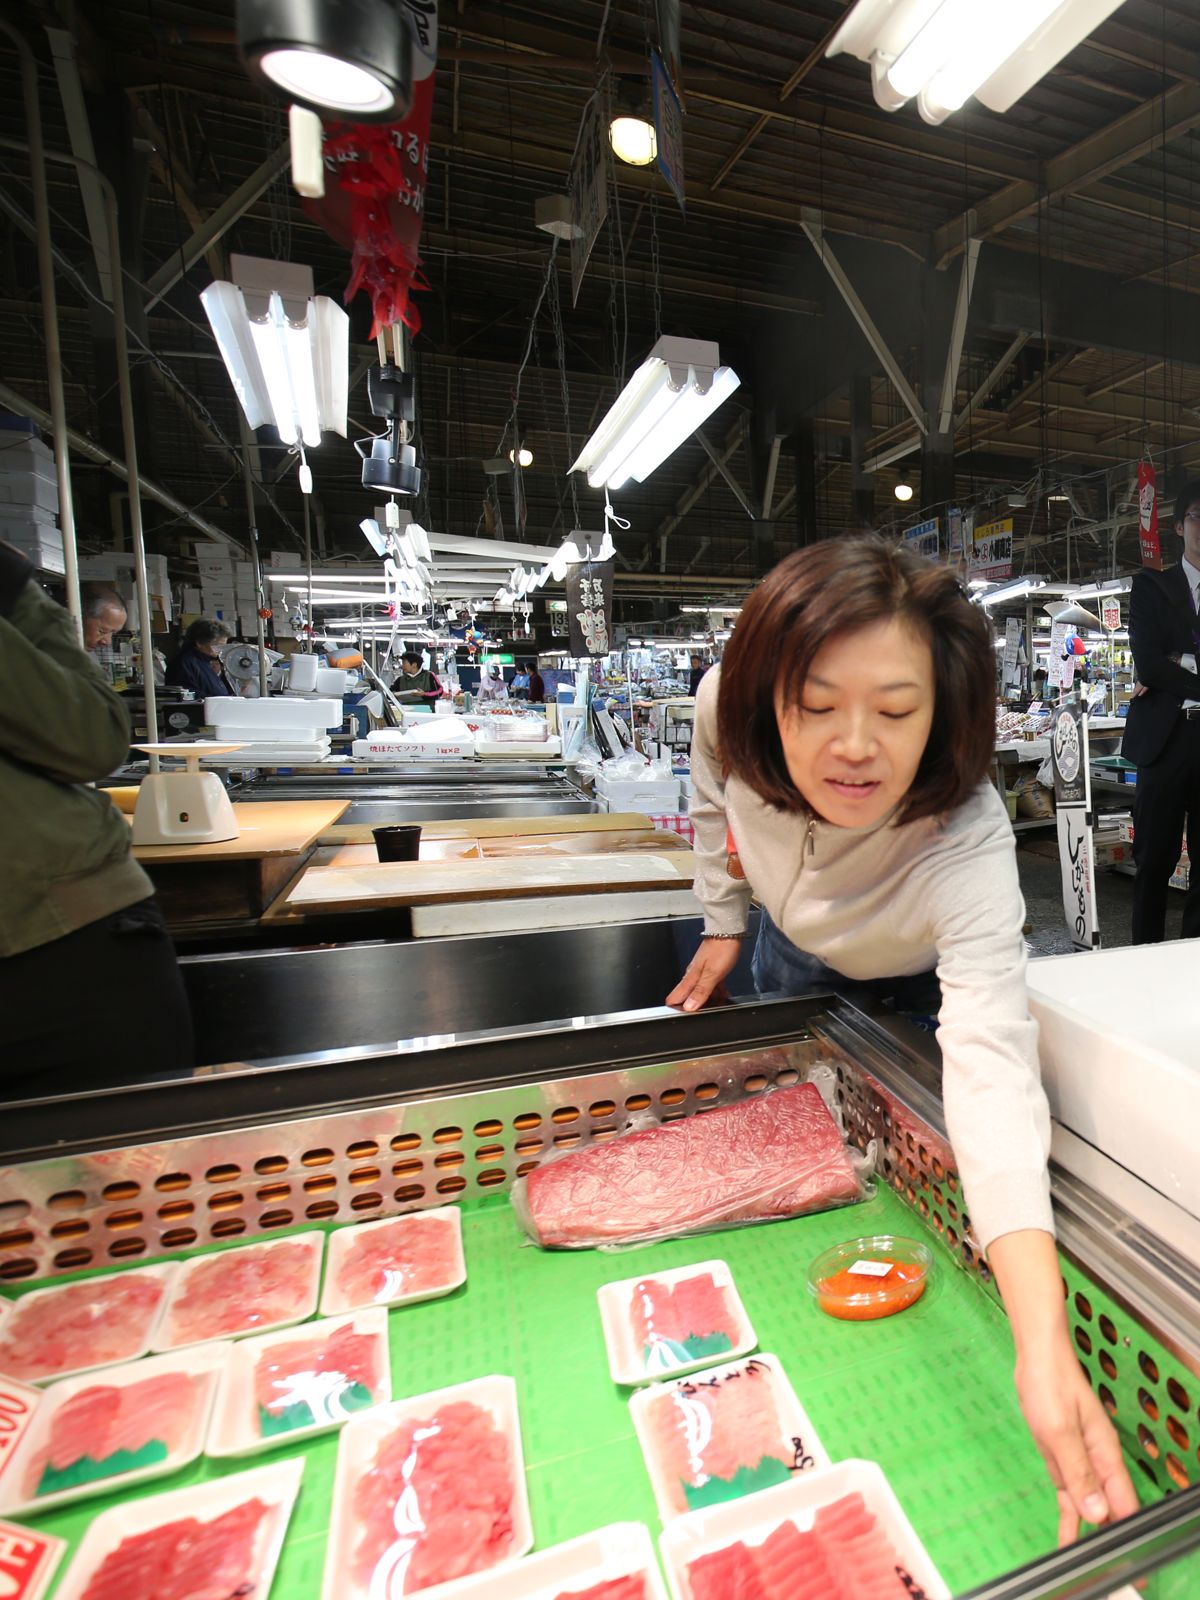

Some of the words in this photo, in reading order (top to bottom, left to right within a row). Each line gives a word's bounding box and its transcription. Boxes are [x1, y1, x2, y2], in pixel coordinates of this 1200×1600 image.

[1066, 812, 1087, 941] ひがしもの
